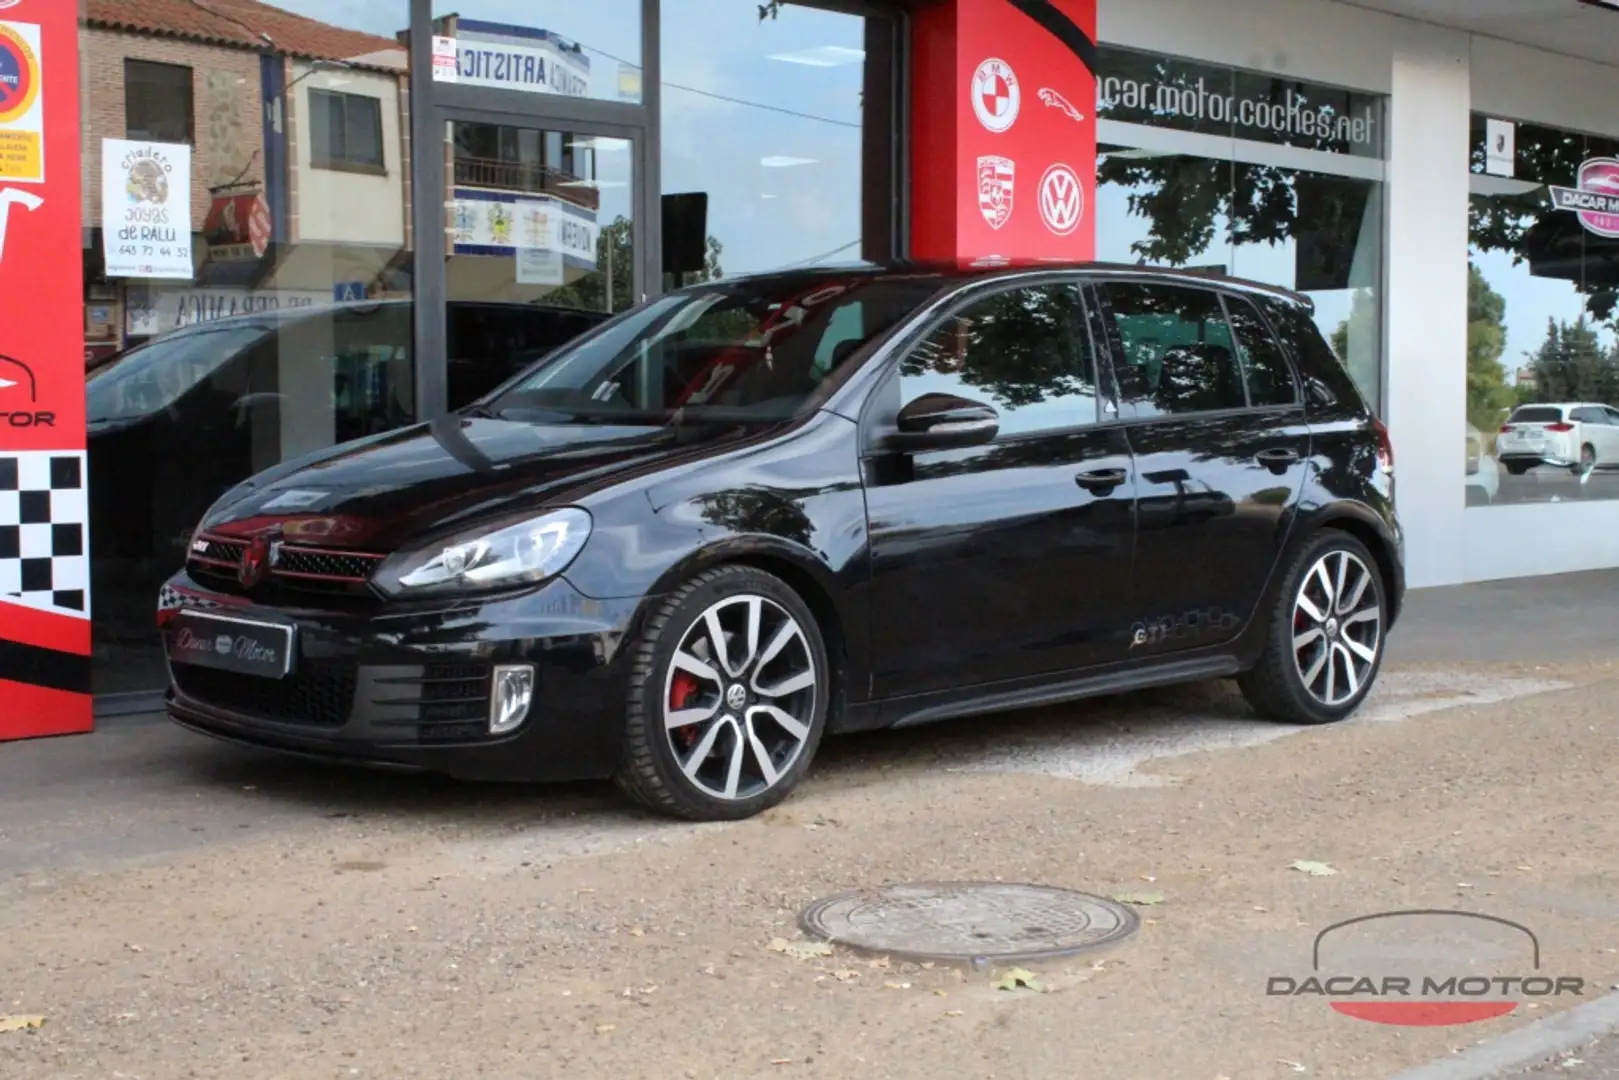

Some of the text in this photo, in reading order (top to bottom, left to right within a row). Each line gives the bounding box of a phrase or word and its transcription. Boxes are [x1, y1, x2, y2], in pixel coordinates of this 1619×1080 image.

[978, 63, 1015, 87] BMW
[121, 146, 172, 171] criadero
[1562, 191, 1606, 210] DACAR
[118, 225, 138, 240] de
